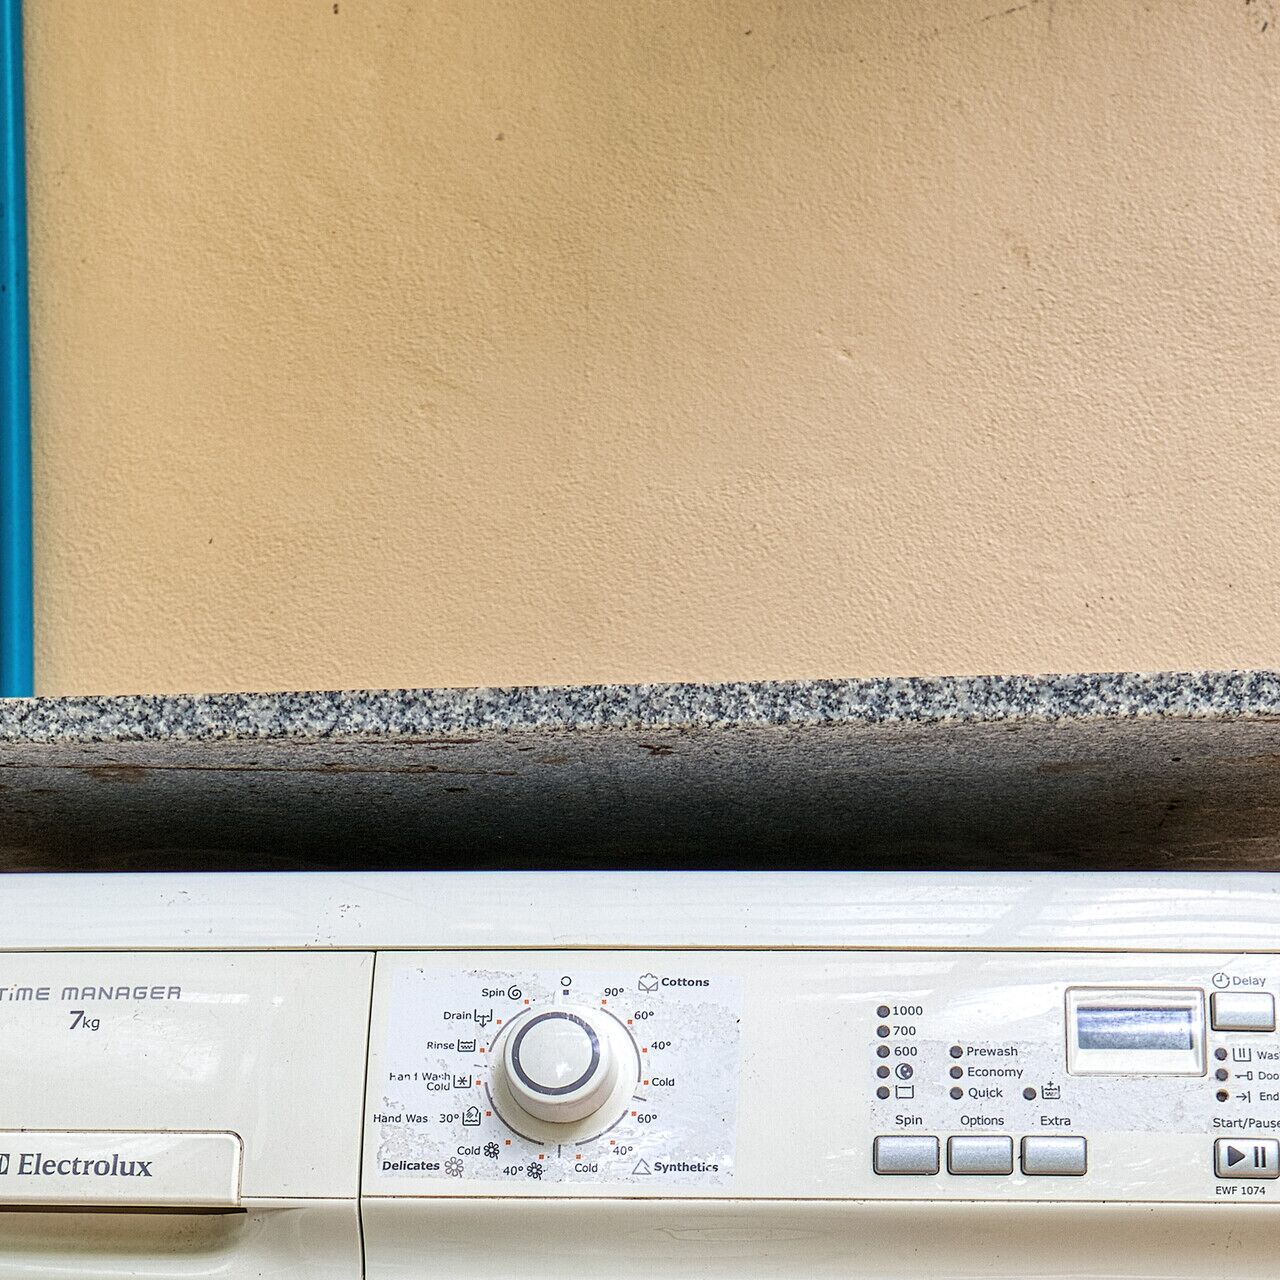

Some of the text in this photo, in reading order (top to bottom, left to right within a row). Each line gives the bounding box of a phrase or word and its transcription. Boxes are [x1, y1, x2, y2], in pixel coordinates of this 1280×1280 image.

[661, 977, 710, 988] Cottons
[1232, 975, 1266, 988] Delay
[61, 986, 182, 1001] MANAGER
[481, 987, 506, 999] Spin
[443, 1010, 472, 1021] Drain
[892, 1006, 924, 1017] 1000
[69, 1010, 101, 1032] 7kg
[893, 1026, 917, 1036] 700
[427, 1040, 455, 1051] Rinse
[894, 1046, 918, 1057] 600
[967, 1045, 1019, 1058] Prewash
[967, 1067, 1024, 1080] Economy
[426, 1081, 451, 1091] Cold
[651, 1077, 675, 1087] Cold
[968, 1087, 1004, 1100] Quick
[1259, 1091, 1280, 1102] End
[373, 1114, 402, 1123] Hand
[895, 1114, 923, 1128] Spin
[960, 1115, 1005, 1128] Options
[1040, 1116, 1072, 1127] Extra
[457, 1146, 481, 1156] Cold
[17, 1152, 153, 1178] Electrolux
[382, 1160, 440, 1172] Delicates
[574, 1162, 598, 1173] Cold
[653, 1161, 719, 1174] Synthetics
[1215, 1186, 1266, 1196] EWF 1074
